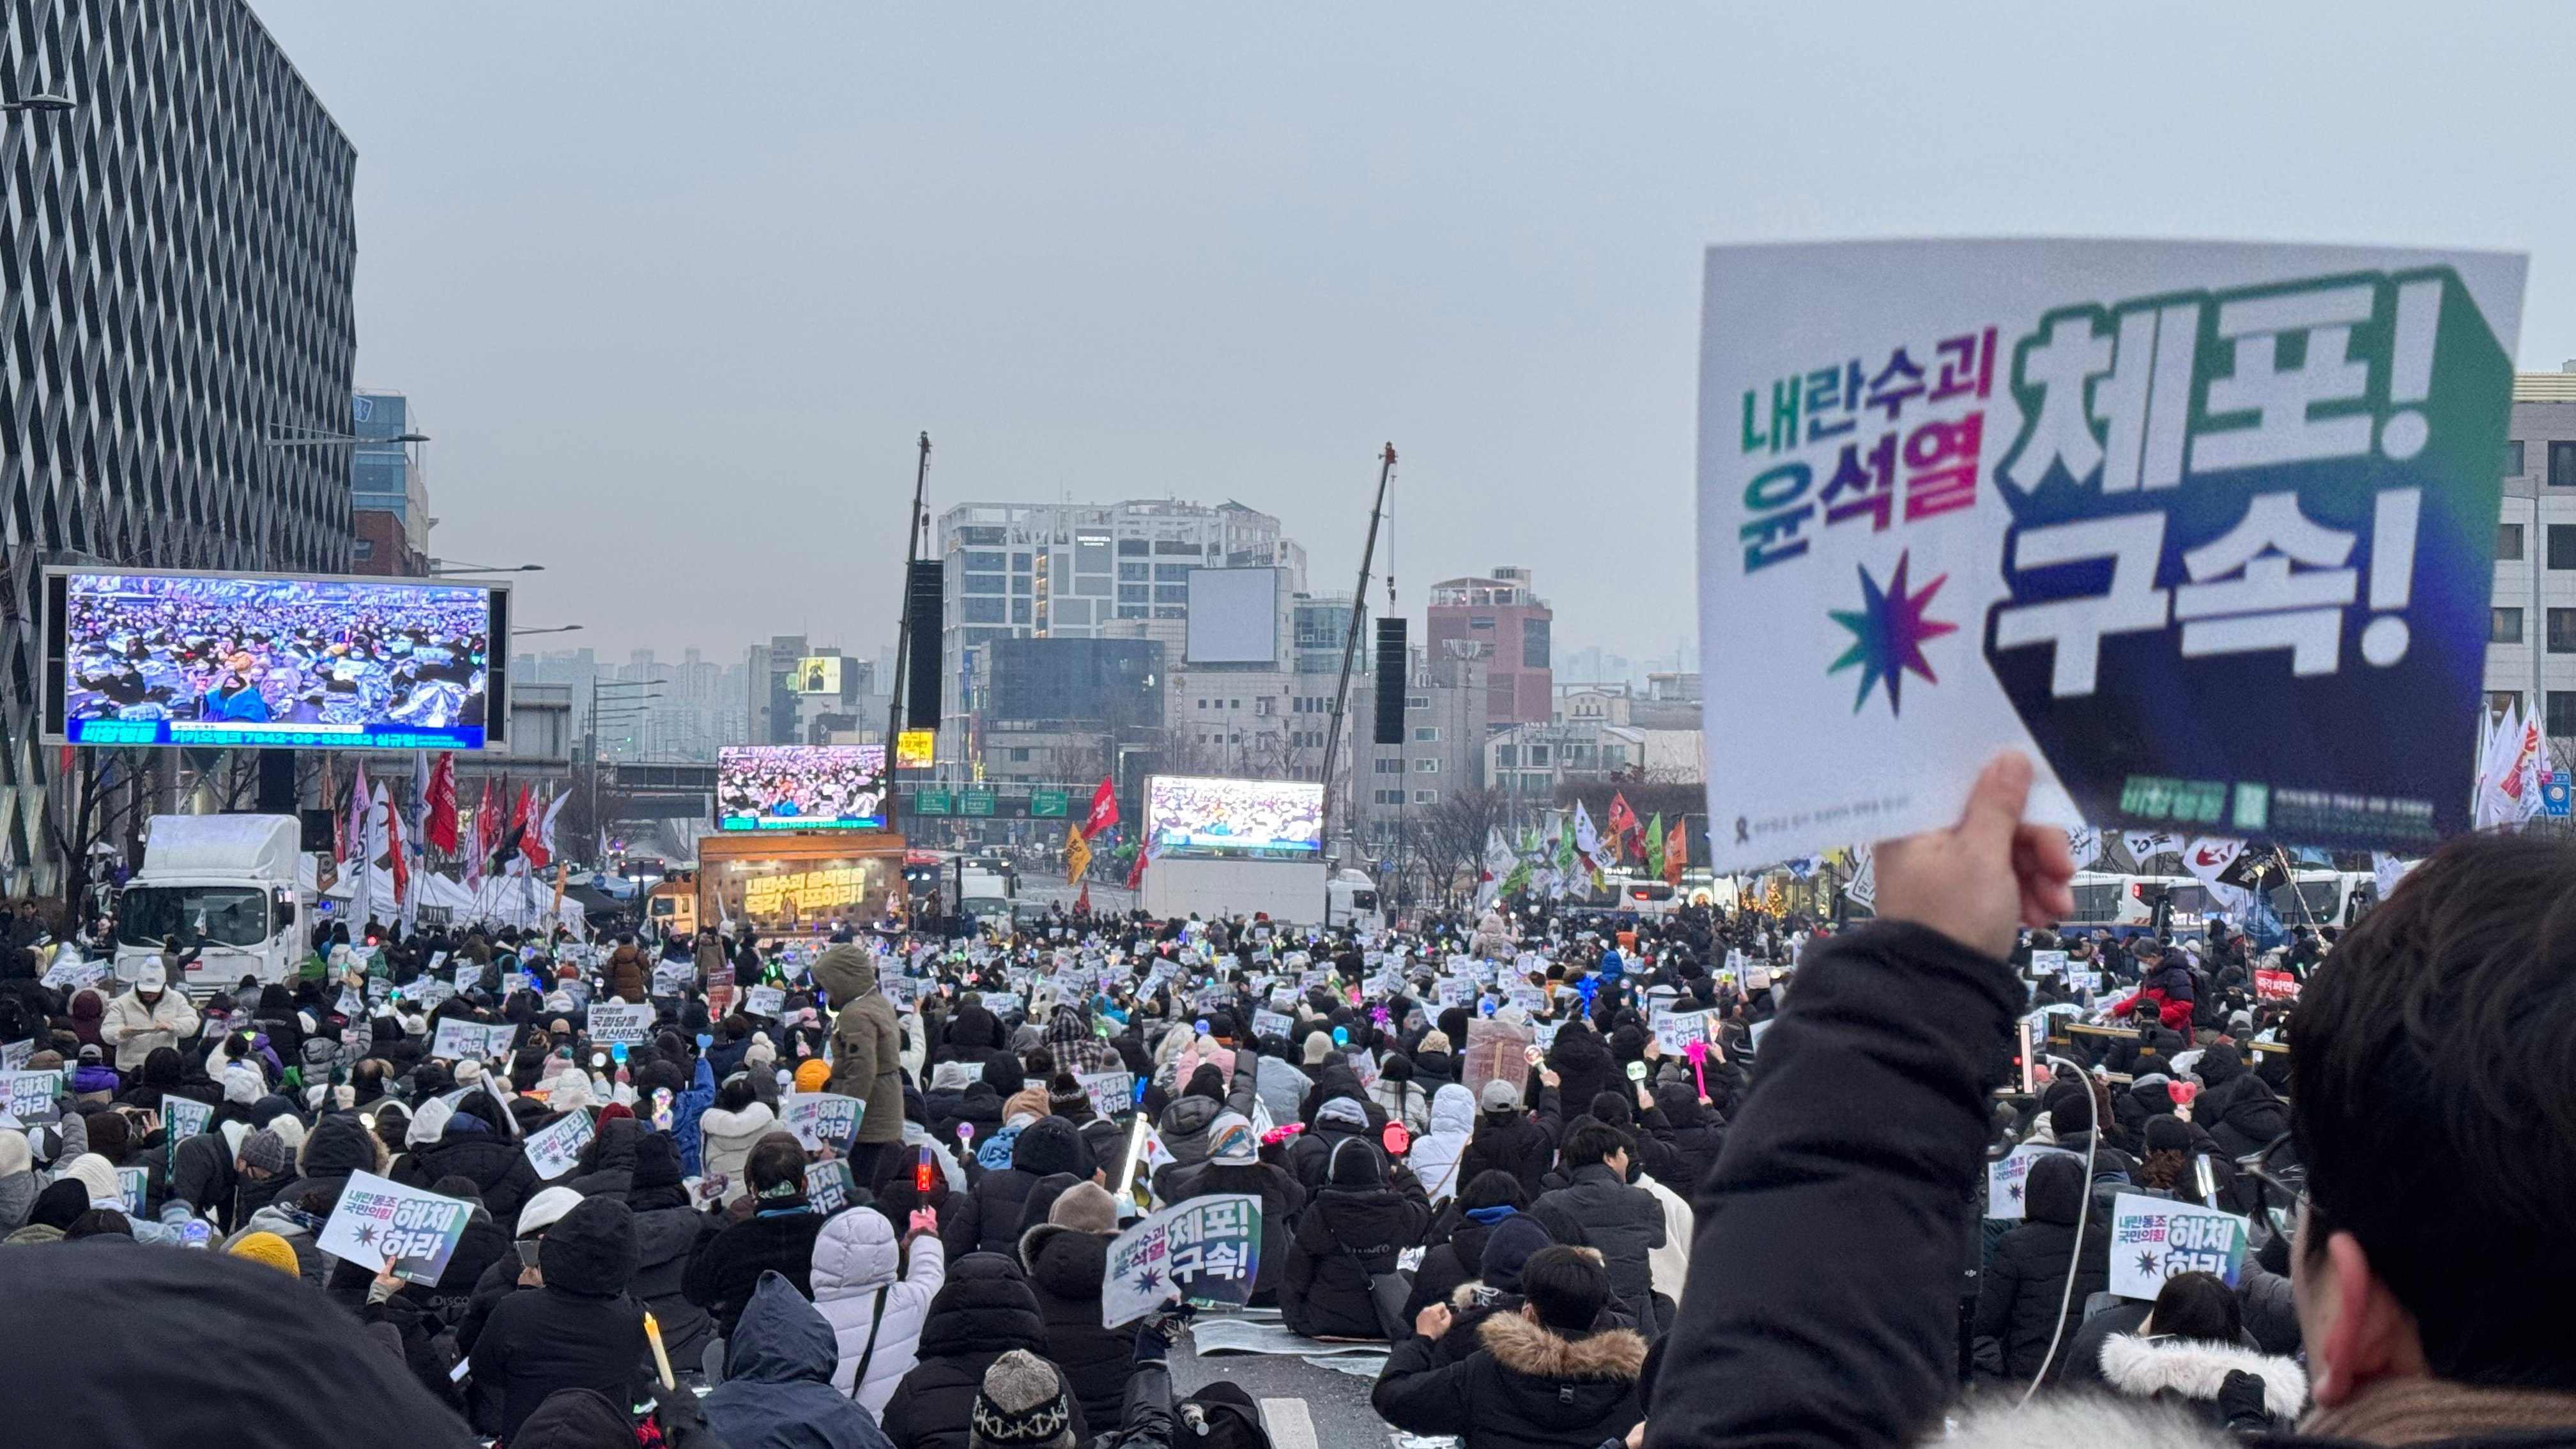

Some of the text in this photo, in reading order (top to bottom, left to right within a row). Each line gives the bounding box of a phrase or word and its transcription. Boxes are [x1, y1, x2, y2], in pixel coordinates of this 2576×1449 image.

[1740, 327, 1998, 455] 내란수괴
[2003, 276, 2444, 497] 체포!
[1738, 411, 1985, 576] 윤석열
[1996, 487, 2421, 700] 구속!
[745, 868, 866, 894] 내란수괴 윤석열을
[745, 892, 783, 915] 즉각
[13, 1074, 54, 1097] 해체
[818, 1100, 856, 1120] 해체
[1102, 1092, 1131, 1114] 하라
[555, 1109, 588, 1144] 체포!
[816, 1119, 852, 1139] 하라
[342, 1201, 394, 1220] 국민의힘
[347, 1189, 399, 1208] 내란동조
[394, 1199, 461, 1232] 해체
[1169, 1200, 1248, 1250] 체포!
[2119, 1215, 2167, 1229] 내란동조
[380, 1230, 445, 1261] 하라
[2119, 1229, 2166, 1244] 국민의힘
[2169, 1216, 2236, 1253] 해체
[1170, 1241, 1248, 1284] 구속!
